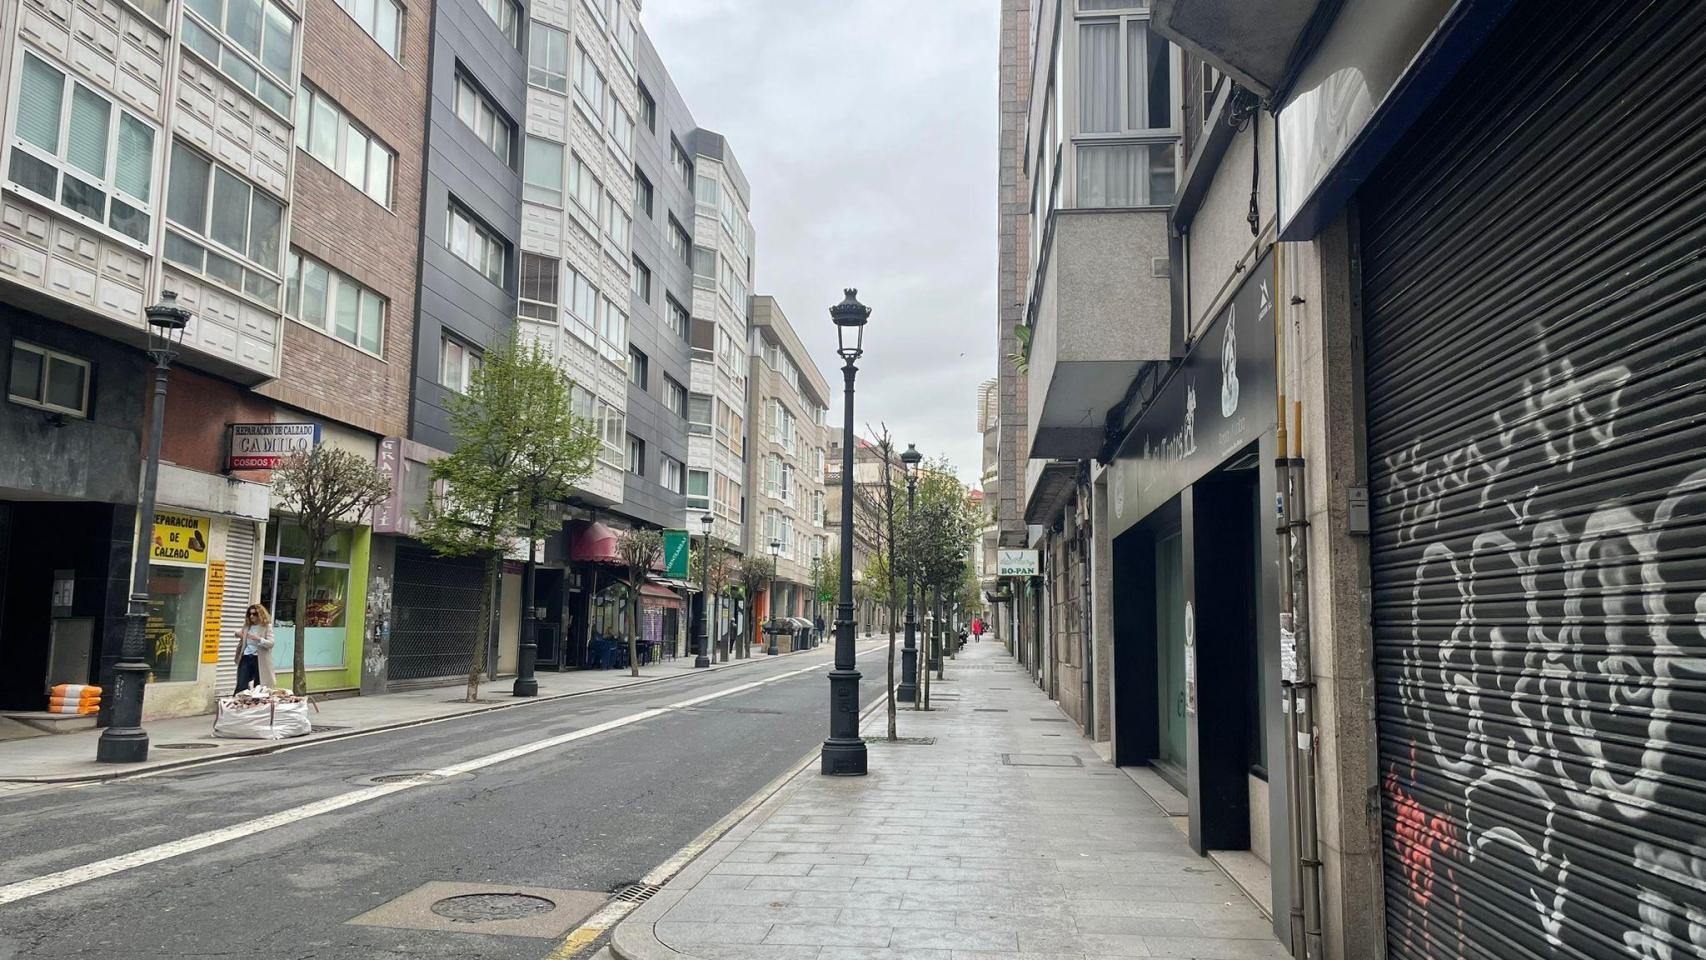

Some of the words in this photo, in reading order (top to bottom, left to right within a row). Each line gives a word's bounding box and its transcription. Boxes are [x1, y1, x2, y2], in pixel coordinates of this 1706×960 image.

[275, 426, 283, 435] DE
[283, 426, 313, 435] CALZADO
[240, 438, 308, 453] CAMILO
[234, 458, 267, 467] COSIDOS
[269, 458, 276, 467] Y
[169, 532, 180, 543] DE
[154, 546, 190, 559] CALZADO
[1001, 567, 1034, 575] BO-PAN
